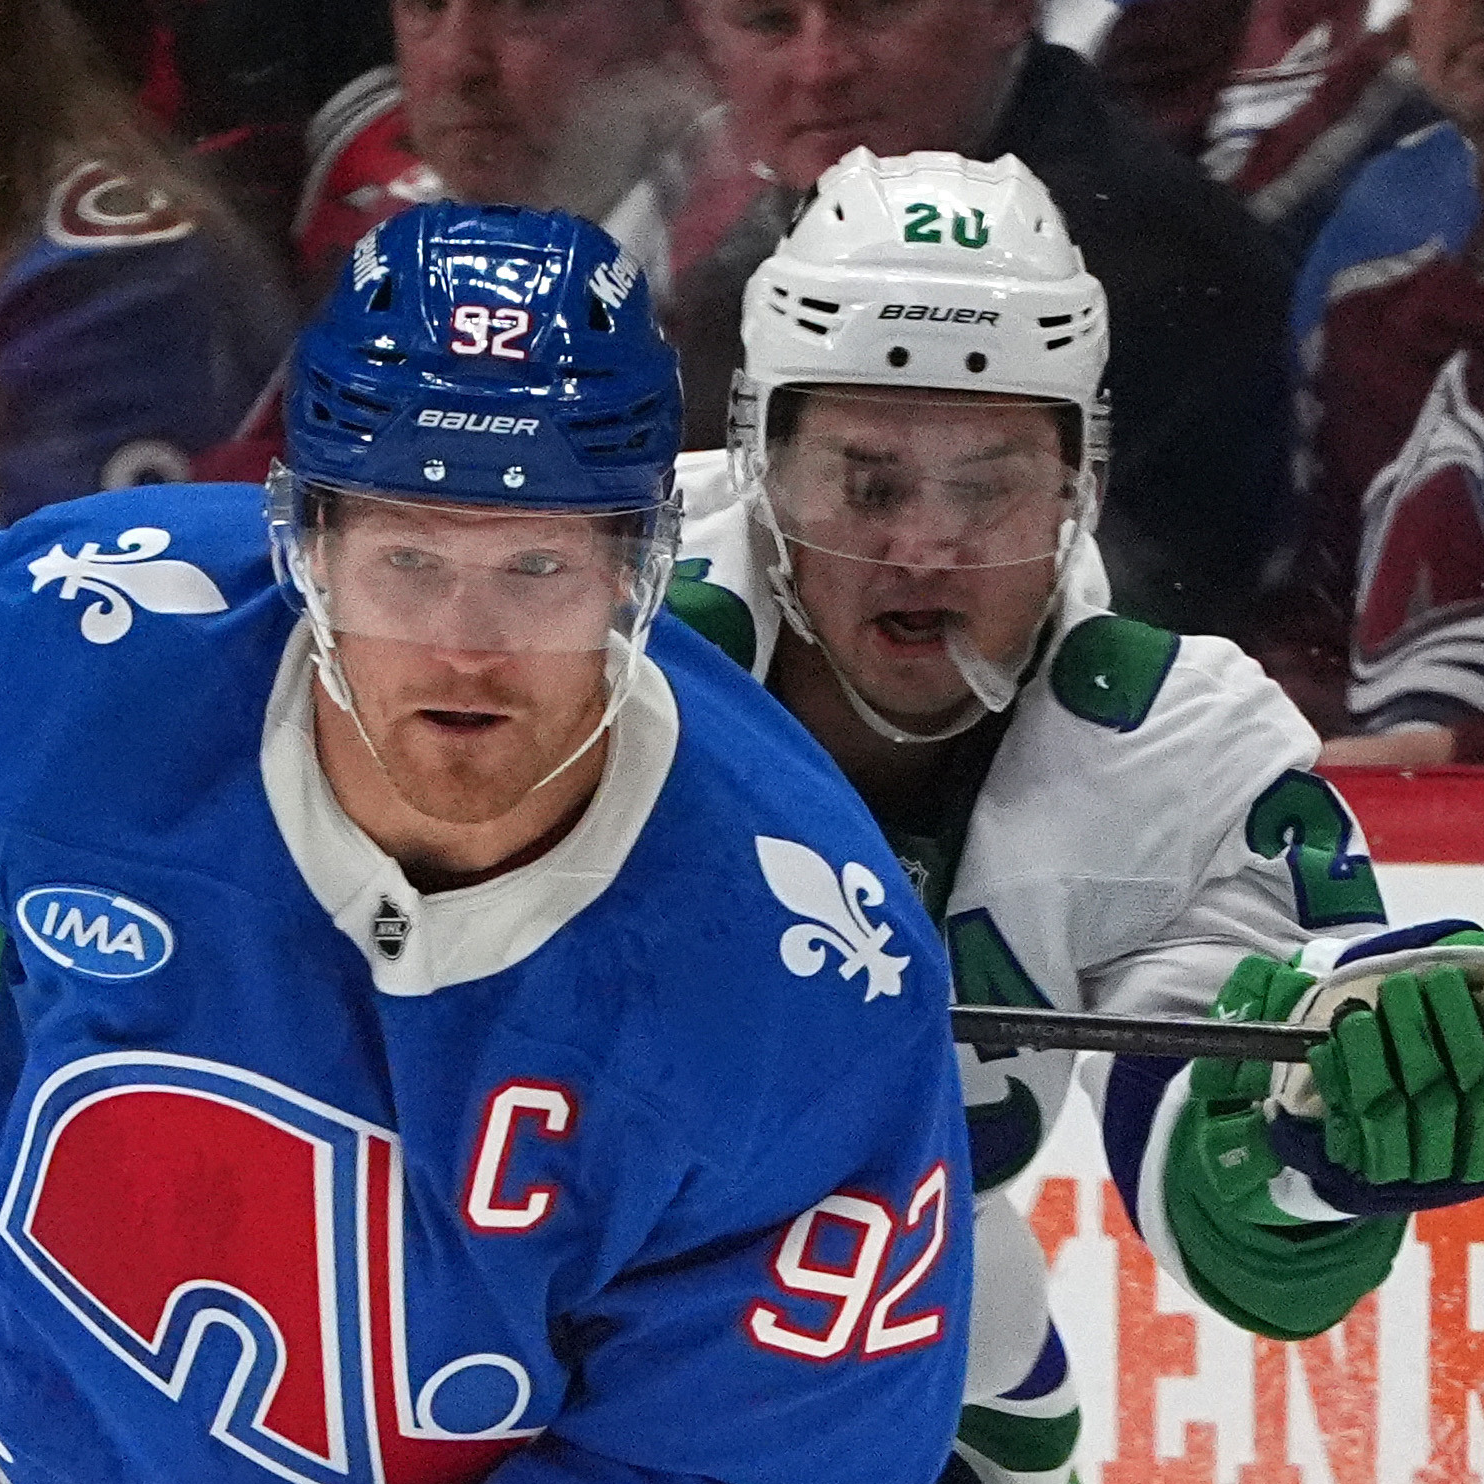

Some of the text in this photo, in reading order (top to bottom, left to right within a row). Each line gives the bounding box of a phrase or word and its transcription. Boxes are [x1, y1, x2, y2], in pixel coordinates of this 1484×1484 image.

[903, 202, 990, 250] 20
[449, 303, 530, 361] 92
[42, 900, 147, 964] IMA
[463, 1078, 577, 1235] C
[744, 1162, 951, 1360] 92
